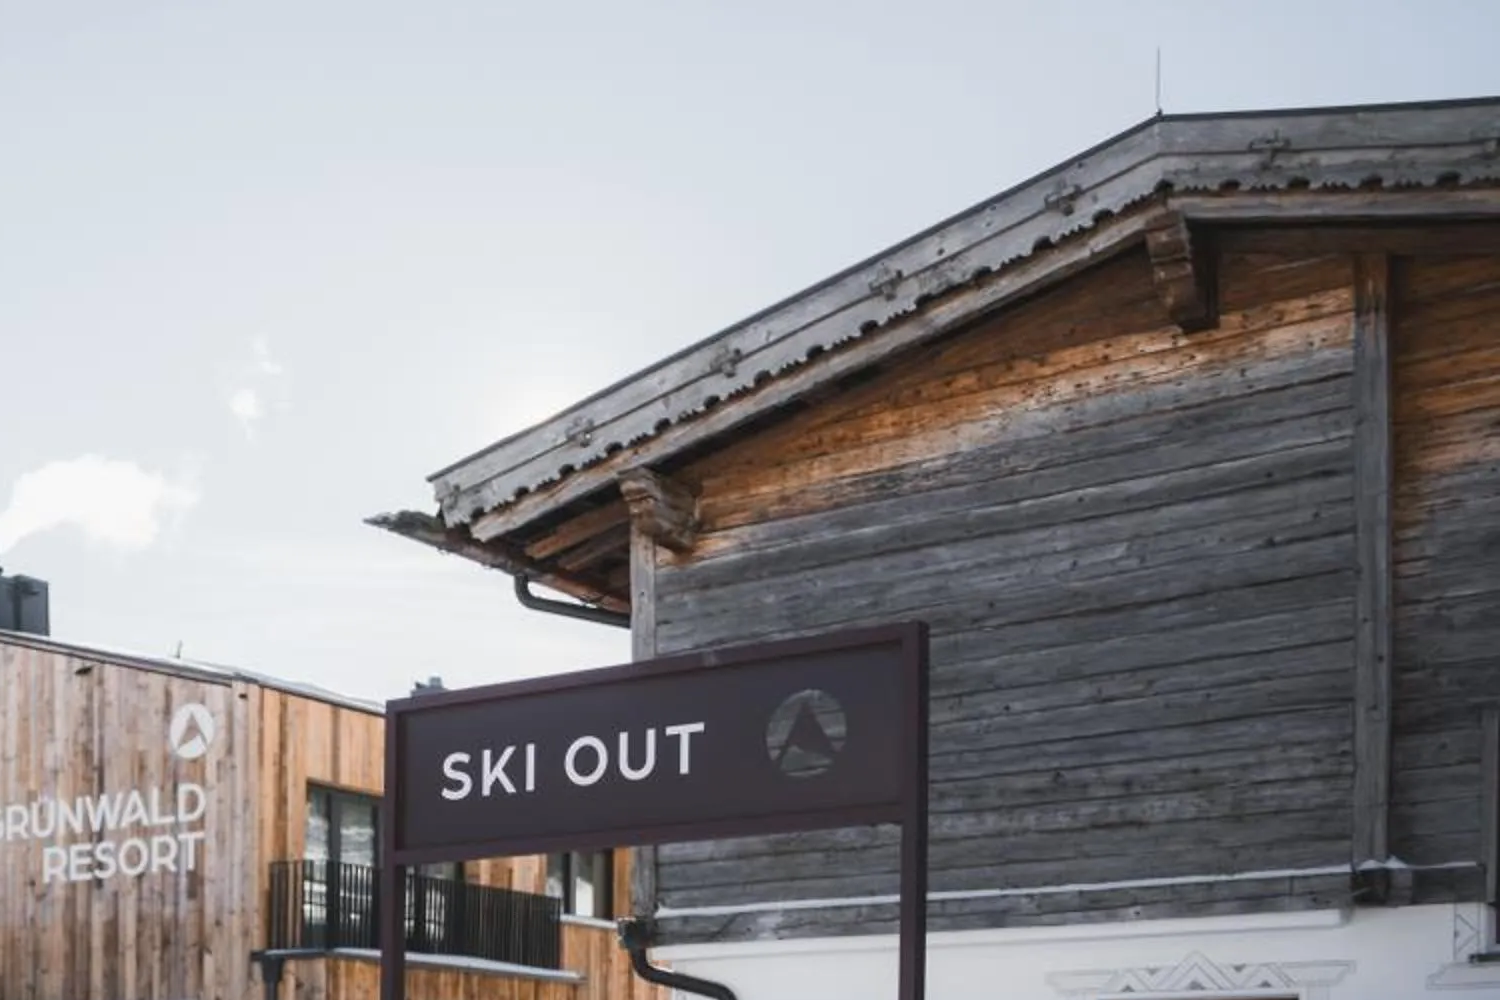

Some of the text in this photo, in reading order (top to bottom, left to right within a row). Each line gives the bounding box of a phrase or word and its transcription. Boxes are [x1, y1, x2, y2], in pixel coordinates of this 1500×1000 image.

[441, 721, 705, 800] SKI OUT
[42, 832, 205, 884] RESORT
